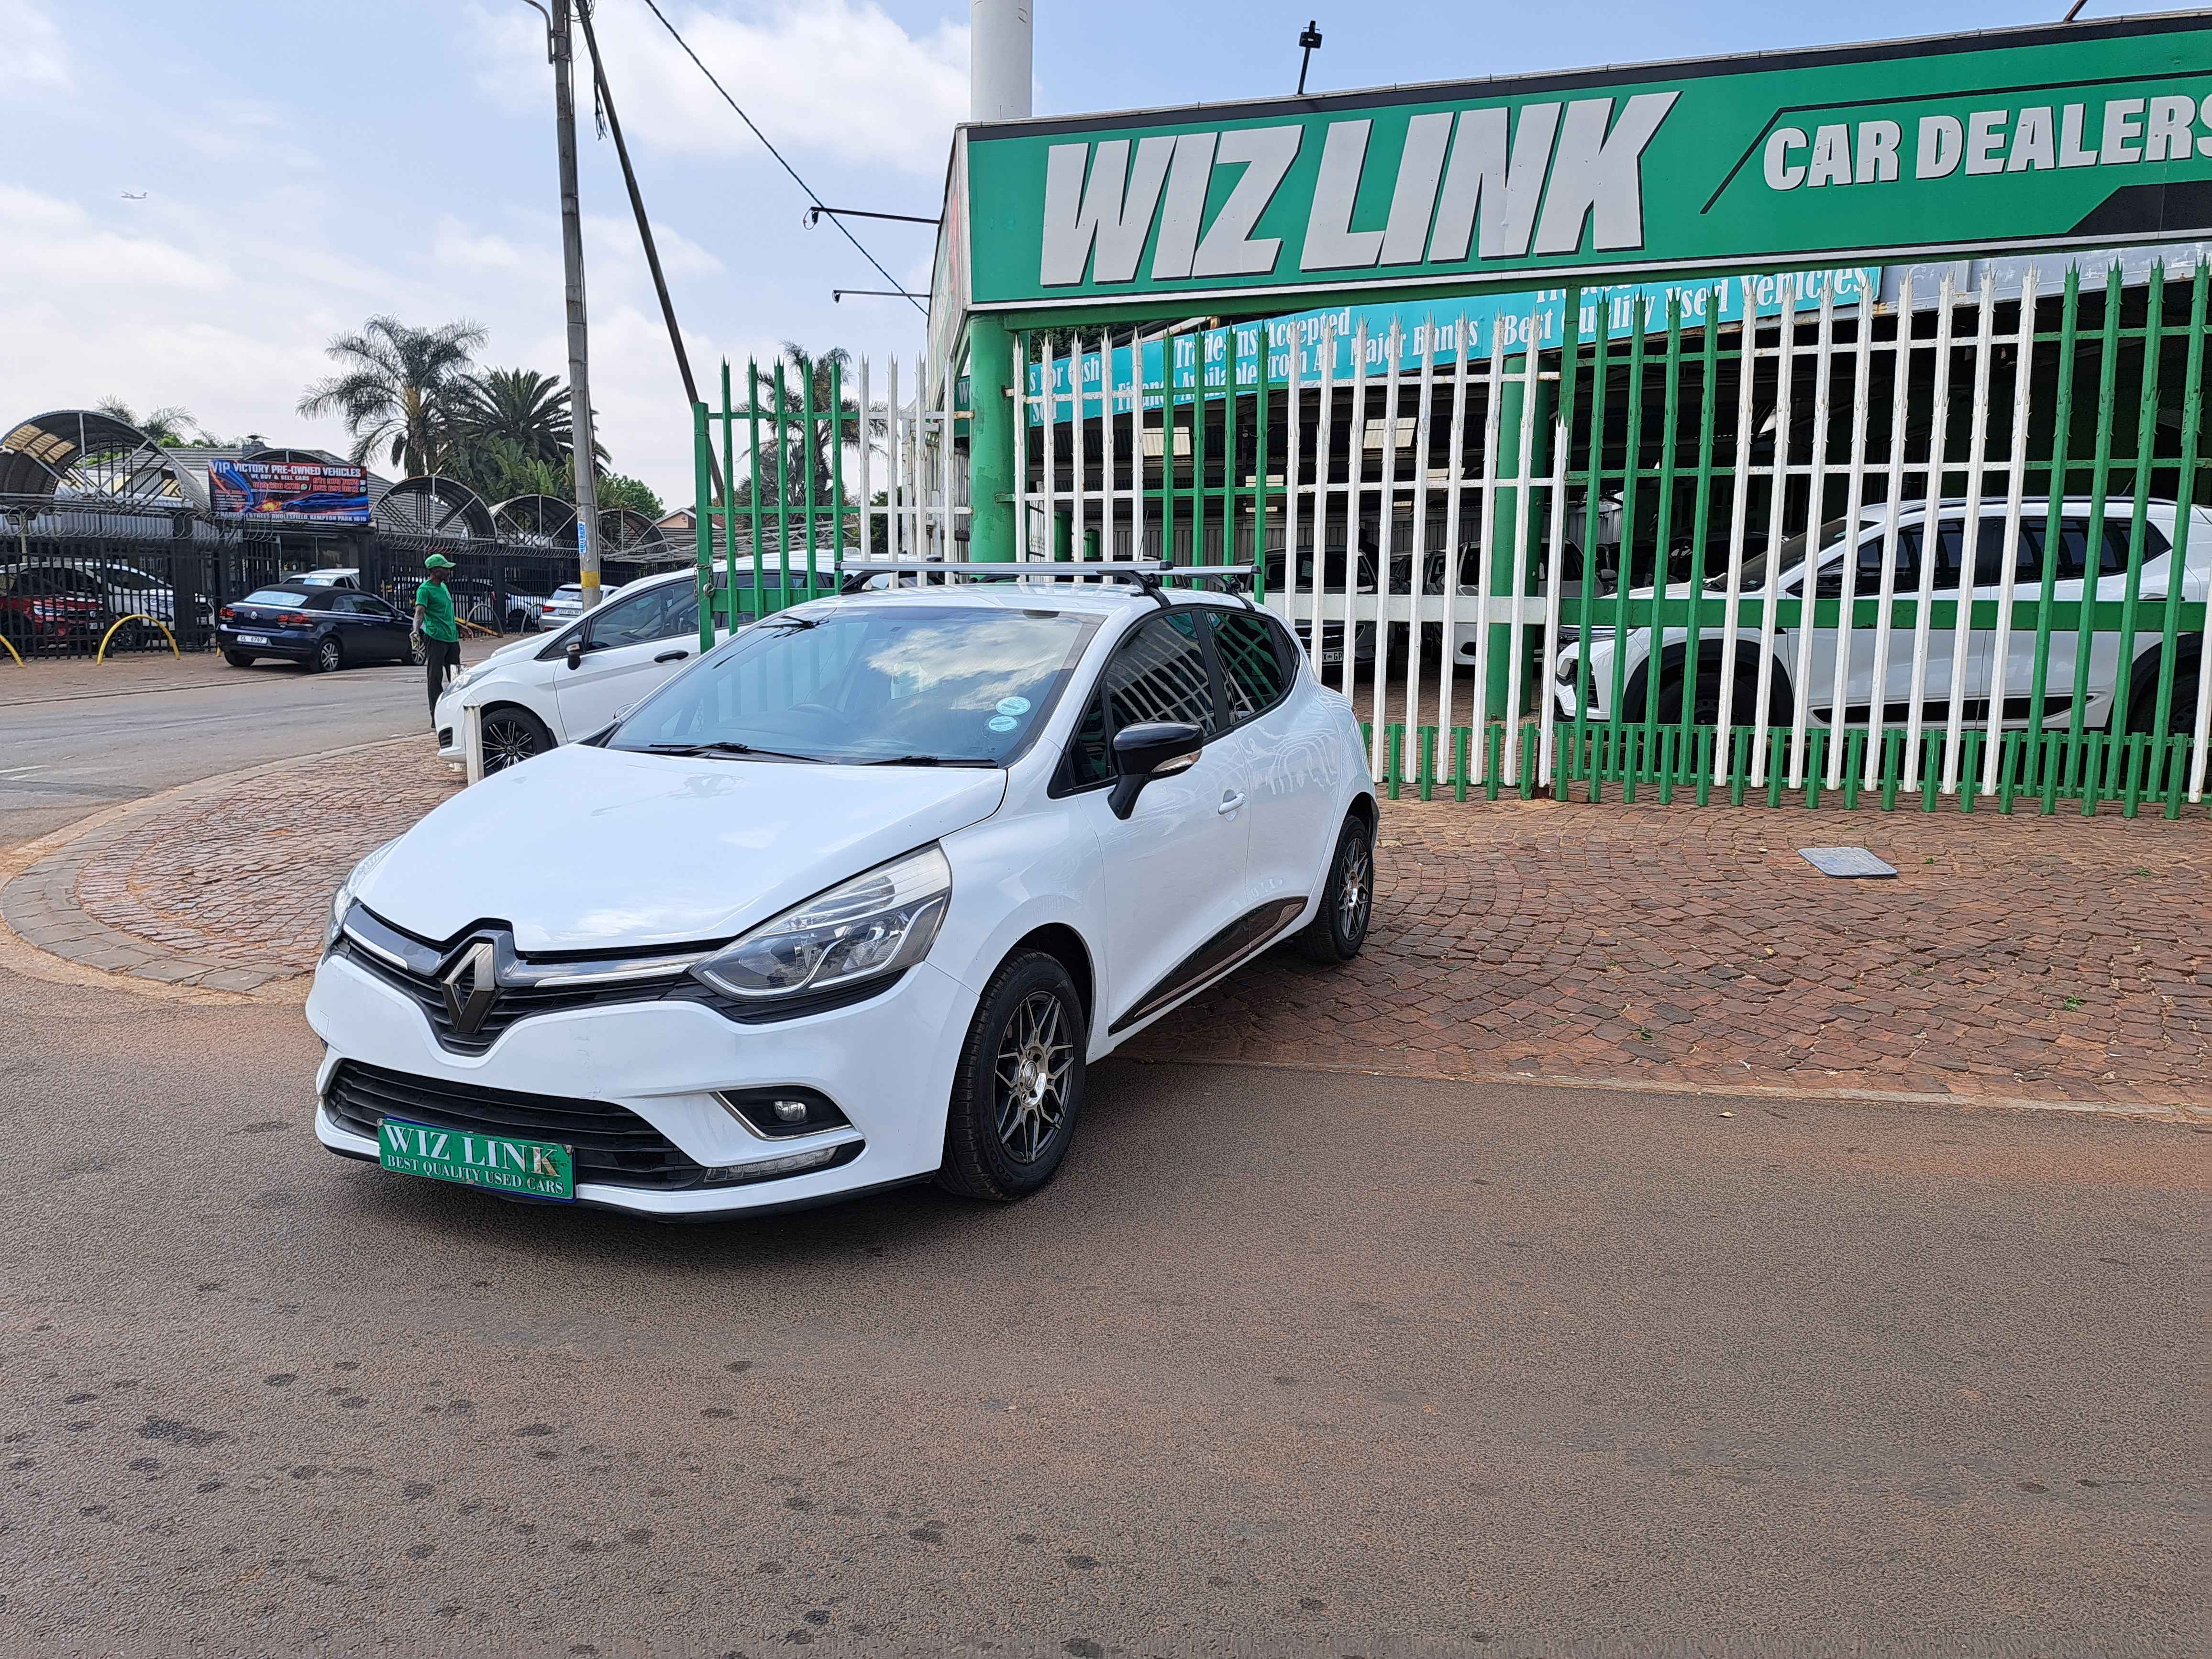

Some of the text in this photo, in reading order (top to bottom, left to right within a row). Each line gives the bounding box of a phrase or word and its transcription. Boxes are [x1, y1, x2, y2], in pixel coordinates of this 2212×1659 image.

[1763, 120, 1902, 191] CAR
[1040, 91, 1683, 286] WIZ LINK
[212, 462, 361, 477] VIP VICTORY PRE-OWNED VEHICLES
[1334, 652, 1342, 661] GP
[384, 1124, 562, 1178] WIZ LINK
[386, 1154, 564, 1195] BEST QUALITY USED CARS
